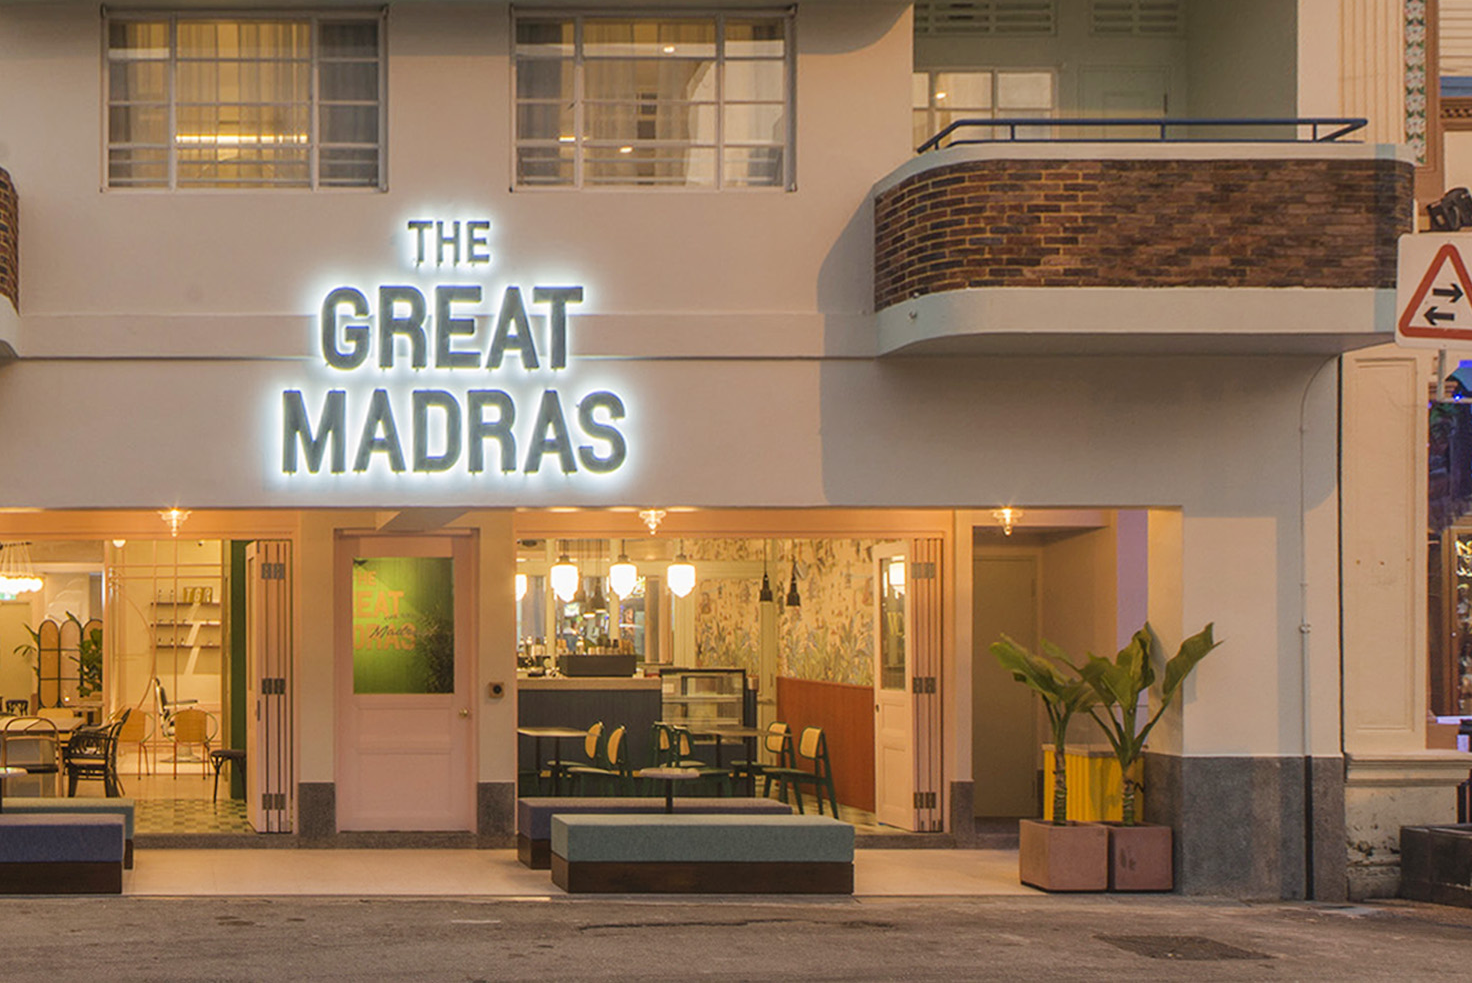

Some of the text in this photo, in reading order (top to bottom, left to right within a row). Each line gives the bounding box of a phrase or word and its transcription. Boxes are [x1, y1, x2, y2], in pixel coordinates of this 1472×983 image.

[408, 221, 490, 266] THE
[321, 286, 583, 371] GREAT
[282, 389, 626, 474] MADRAS
[357, 570, 377, 587] HE
[353, 590, 405, 618] EAT
[353, 622, 417, 651] DRAS
